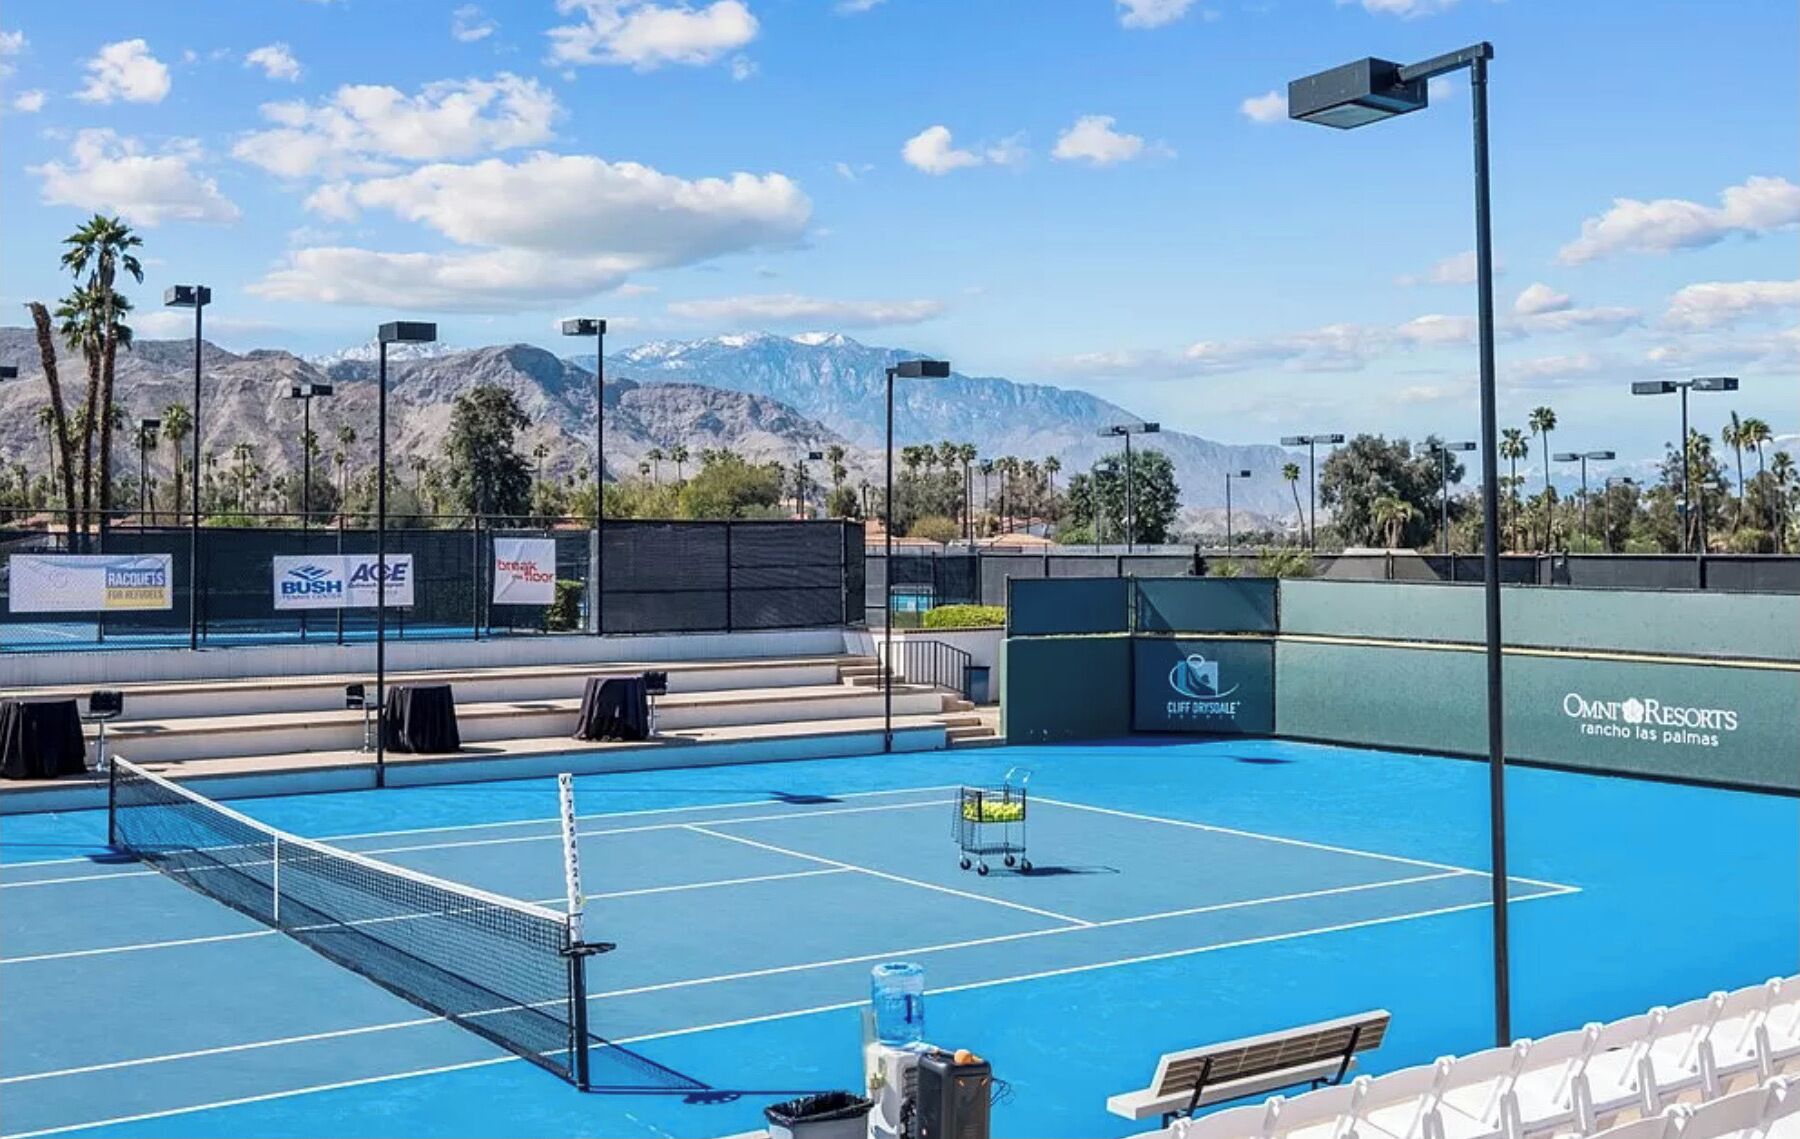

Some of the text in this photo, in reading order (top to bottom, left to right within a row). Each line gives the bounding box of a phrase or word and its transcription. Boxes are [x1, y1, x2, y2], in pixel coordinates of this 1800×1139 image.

[108, 571, 164, 586] RACQUETS
[281, 580, 342, 594] BUSH
[1167, 702, 1191, 714] CLIFF
[1563, 692, 1738, 731] OMNI RESORTS
[1581, 723, 1720, 747] rancho las palmas
